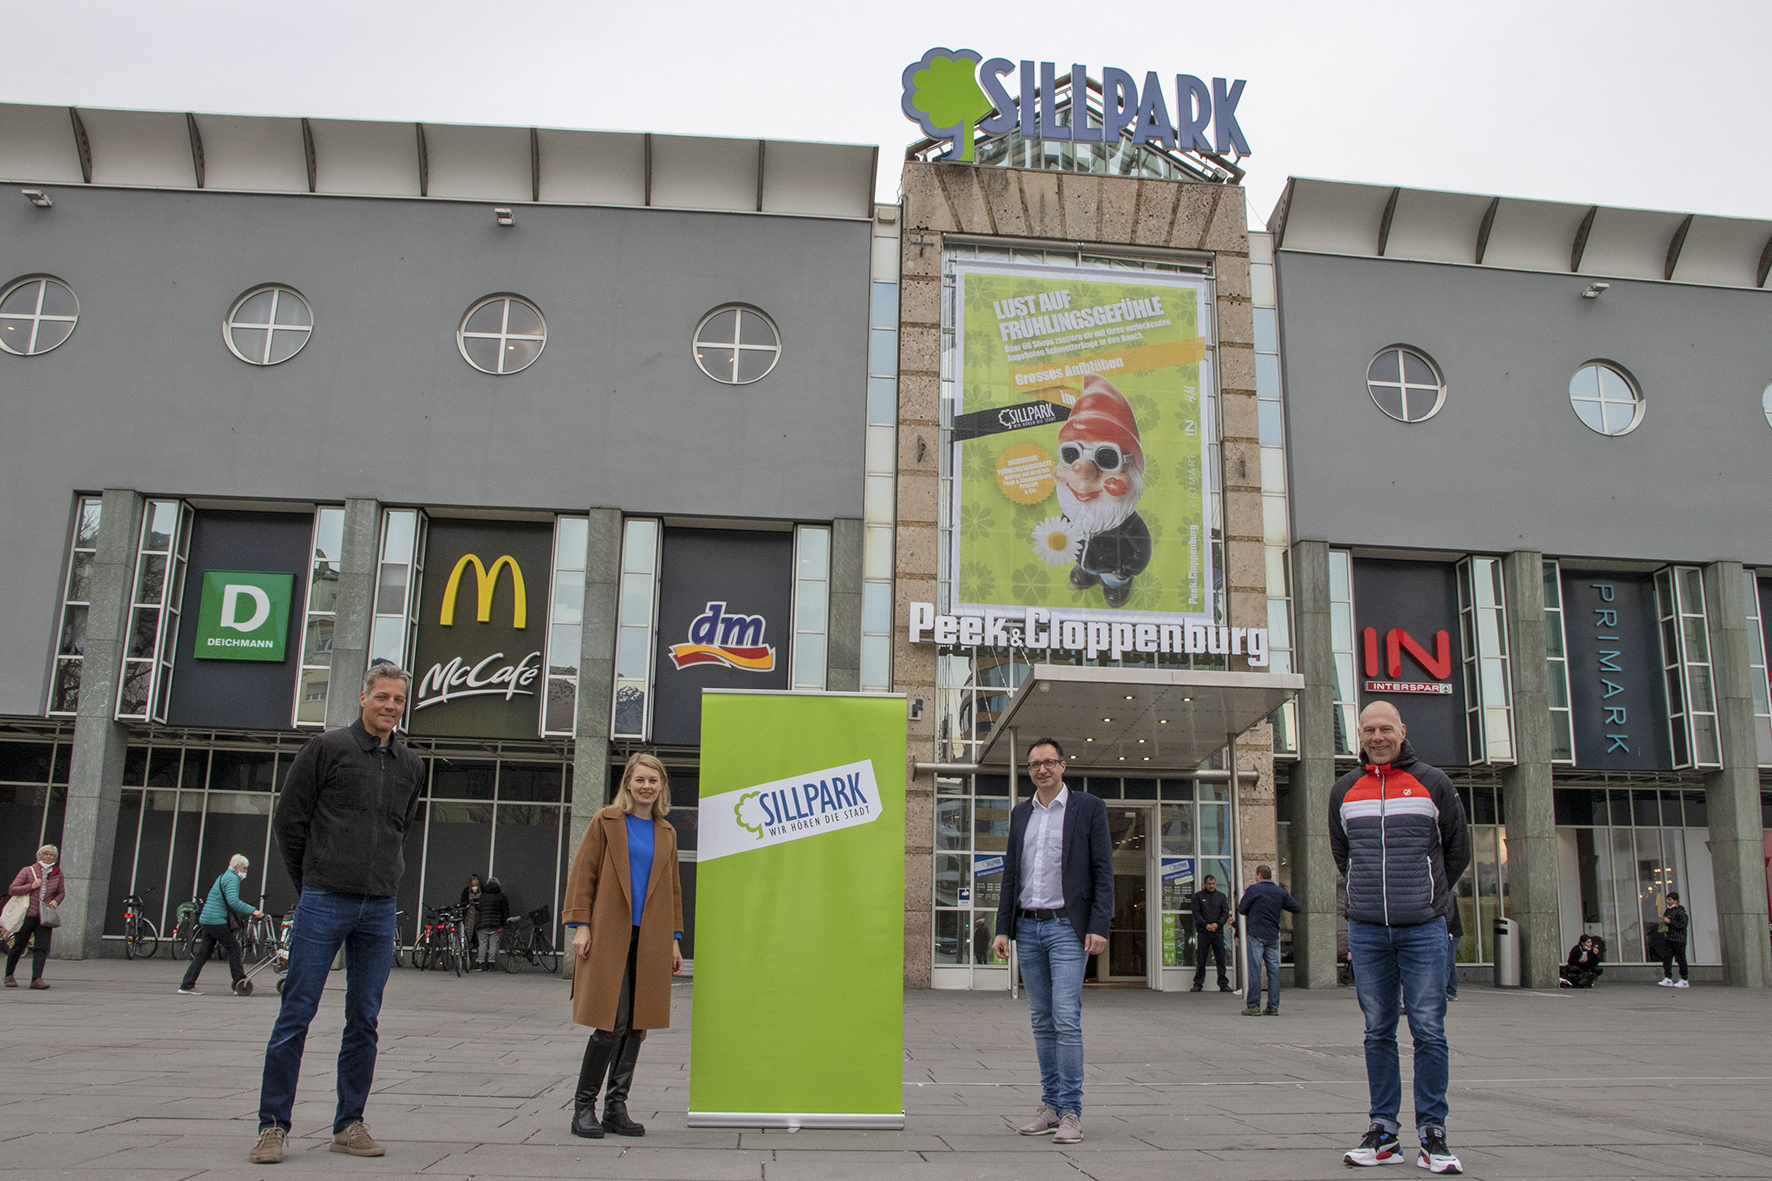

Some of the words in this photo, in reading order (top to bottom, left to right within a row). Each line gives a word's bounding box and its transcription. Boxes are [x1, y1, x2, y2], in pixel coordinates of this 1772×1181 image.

[979, 58, 1252, 157] SILLPARK
[994, 295, 1036, 320] LUST
[1039, 290, 1071, 312] AUF
[999, 297, 1164, 341] FRÜHLINGSGEFÜHLE
[1007, 348, 1045, 362] Angeboten
[1046, 340, 1098, 358] Schmetterlinge
[1107, 335, 1120, 344] den
[1121, 332, 1144, 342] Bauch.
[1033, 338, 1054, 349] Shops
[1055, 334, 1082, 345] zaubern
[1084, 332, 1093, 340] dir
[1094, 329, 1105, 338] mit
[1125, 318, 1171, 333] verlockenden
[1015, 368, 1063, 386] Grosses
[1065, 357, 1124, 377] Aufblühen
[1008, 402, 1055, 424] SILLPARK
[1060, 390, 1076, 406] im
[1185, 420, 1194, 436] IN
[1188, 450, 1196, 507] PRIMARK
[220, 584, 270, 632] D
[690, 602, 765, 646] dm
[207, 638, 274, 648] DEICHMANN
[1364, 627, 1452, 680] IN
[418, 651, 540, 703] McCafé
[1591, 584, 1630, 754] PRIMARK
[1373, 683, 1440, 692] INTERSPAR
[759, 772, 868, 827] SILLPARK
[769, 826, 787, 837] WIR
[792, 817, 821, 832] HÖREN
[825, 813, 840, 824] DIE
[844, 805, 871, 820] STADT
